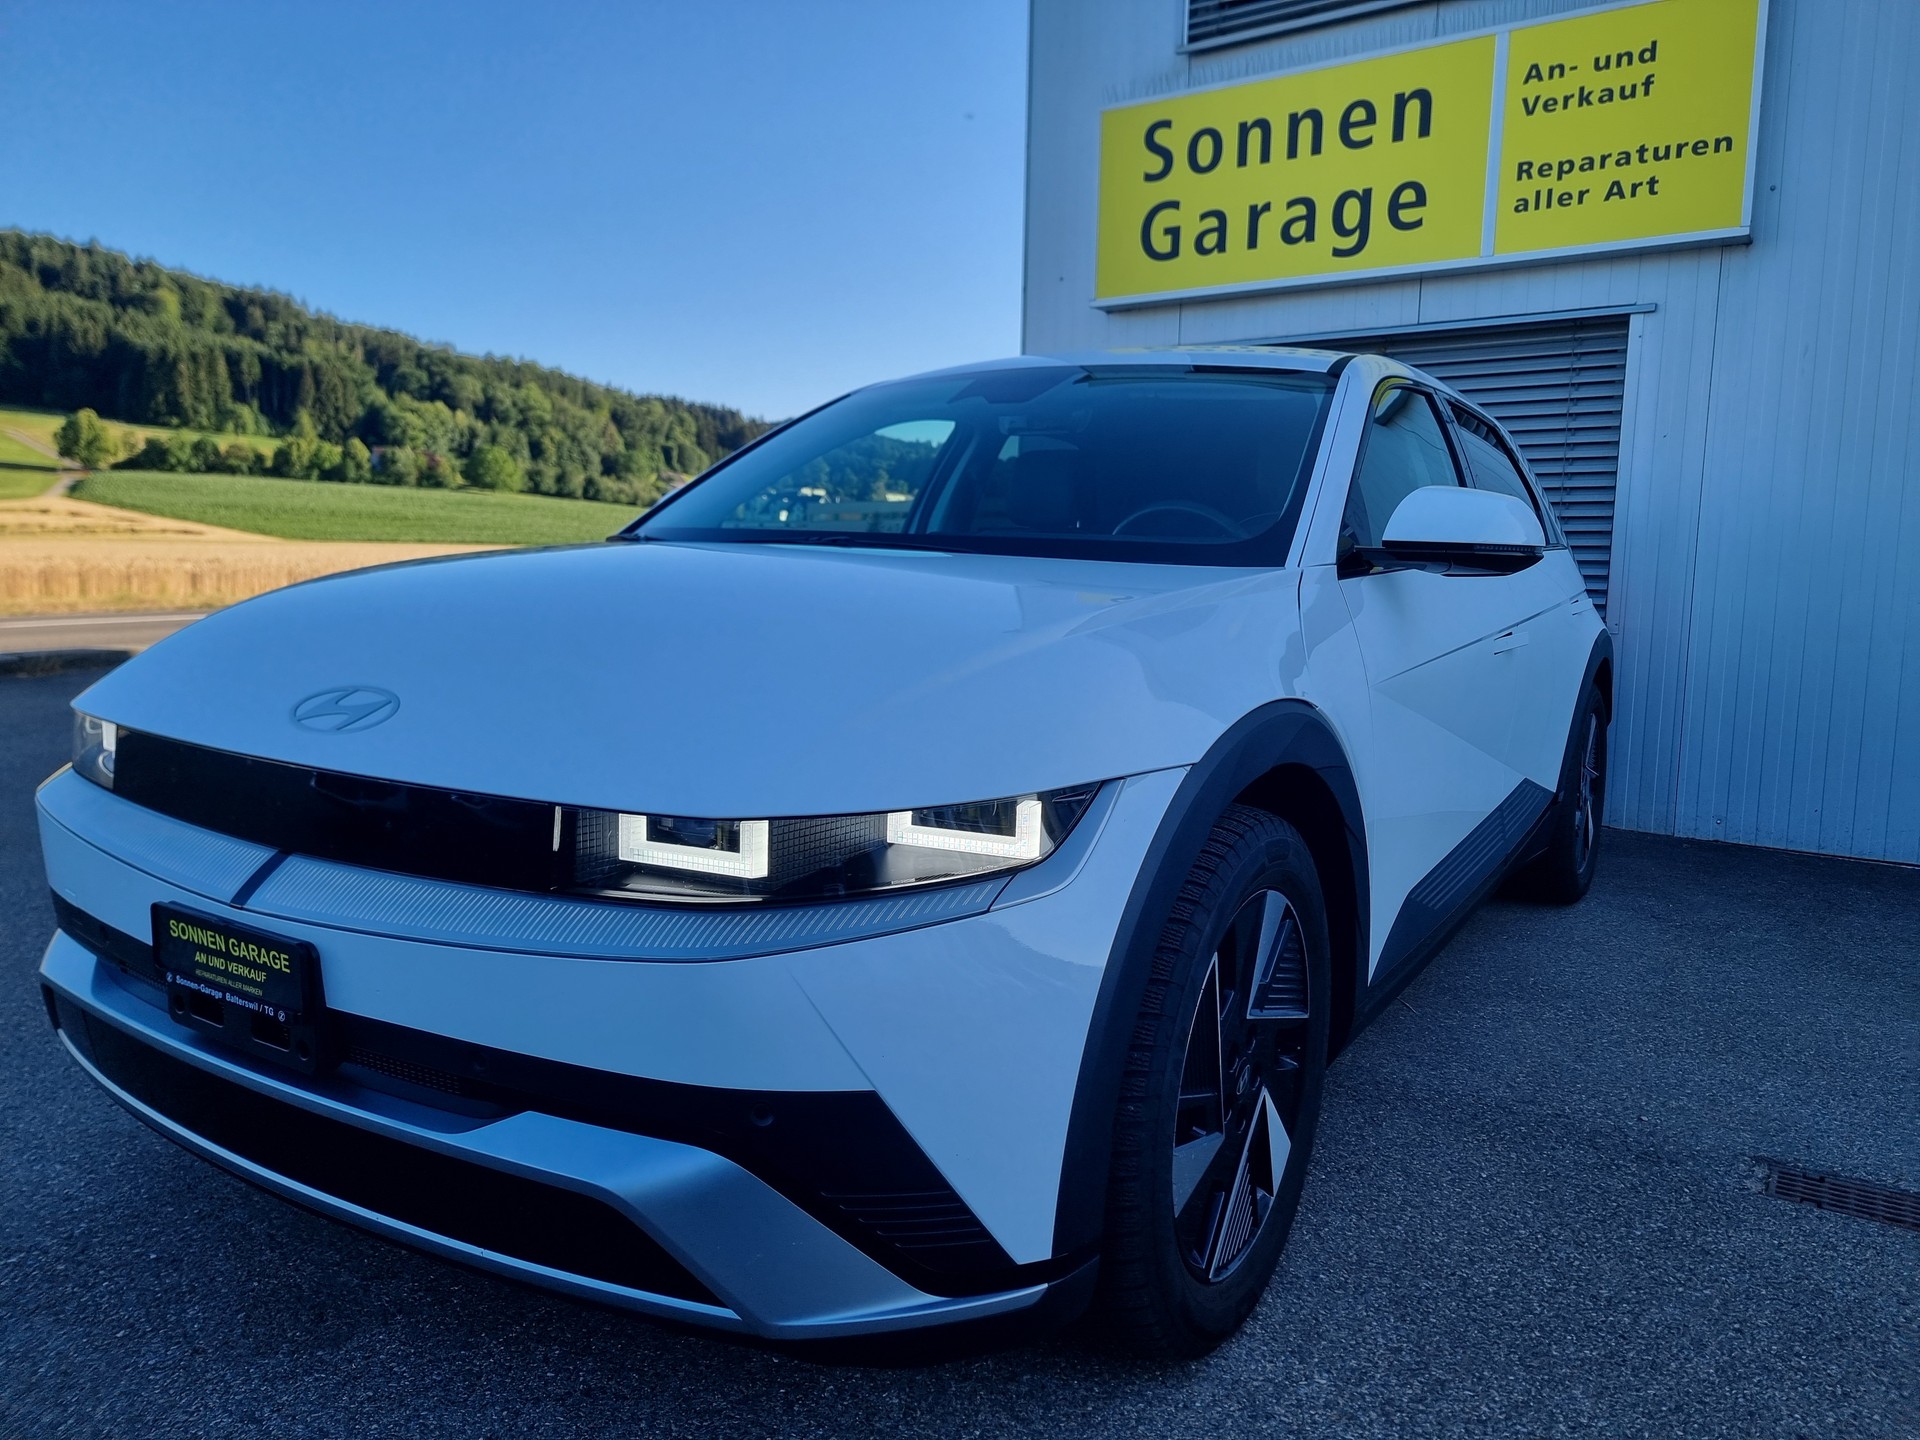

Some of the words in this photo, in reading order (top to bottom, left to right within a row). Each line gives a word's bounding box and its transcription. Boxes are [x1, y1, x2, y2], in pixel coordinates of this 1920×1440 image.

[1522, 60, 1580, 86] An-
[1592, 40, 1659, 71] und
[1521, 74, 1657, 118] Verkauf
[1143, 86, 1434, 184] Sonnen
[1516, 133, 1735, 182] Reparaturen
[1513, 185, 1590, 214] aller
[1602, 175, 1660, 203] Art
[1140, 177, 1429, 262] Garage
[169, 919, 226, 952] SONNEN
[229, 938, 291, 974] GARAGE
[194, 951, 207, 964] AN
[208, 955, 226, 970] UND
[227, 961, 267, 983] VERKAUF
[175, 975, 223, 999] Sonnen-Garage
[263, 1005, 275, 1016] TG
